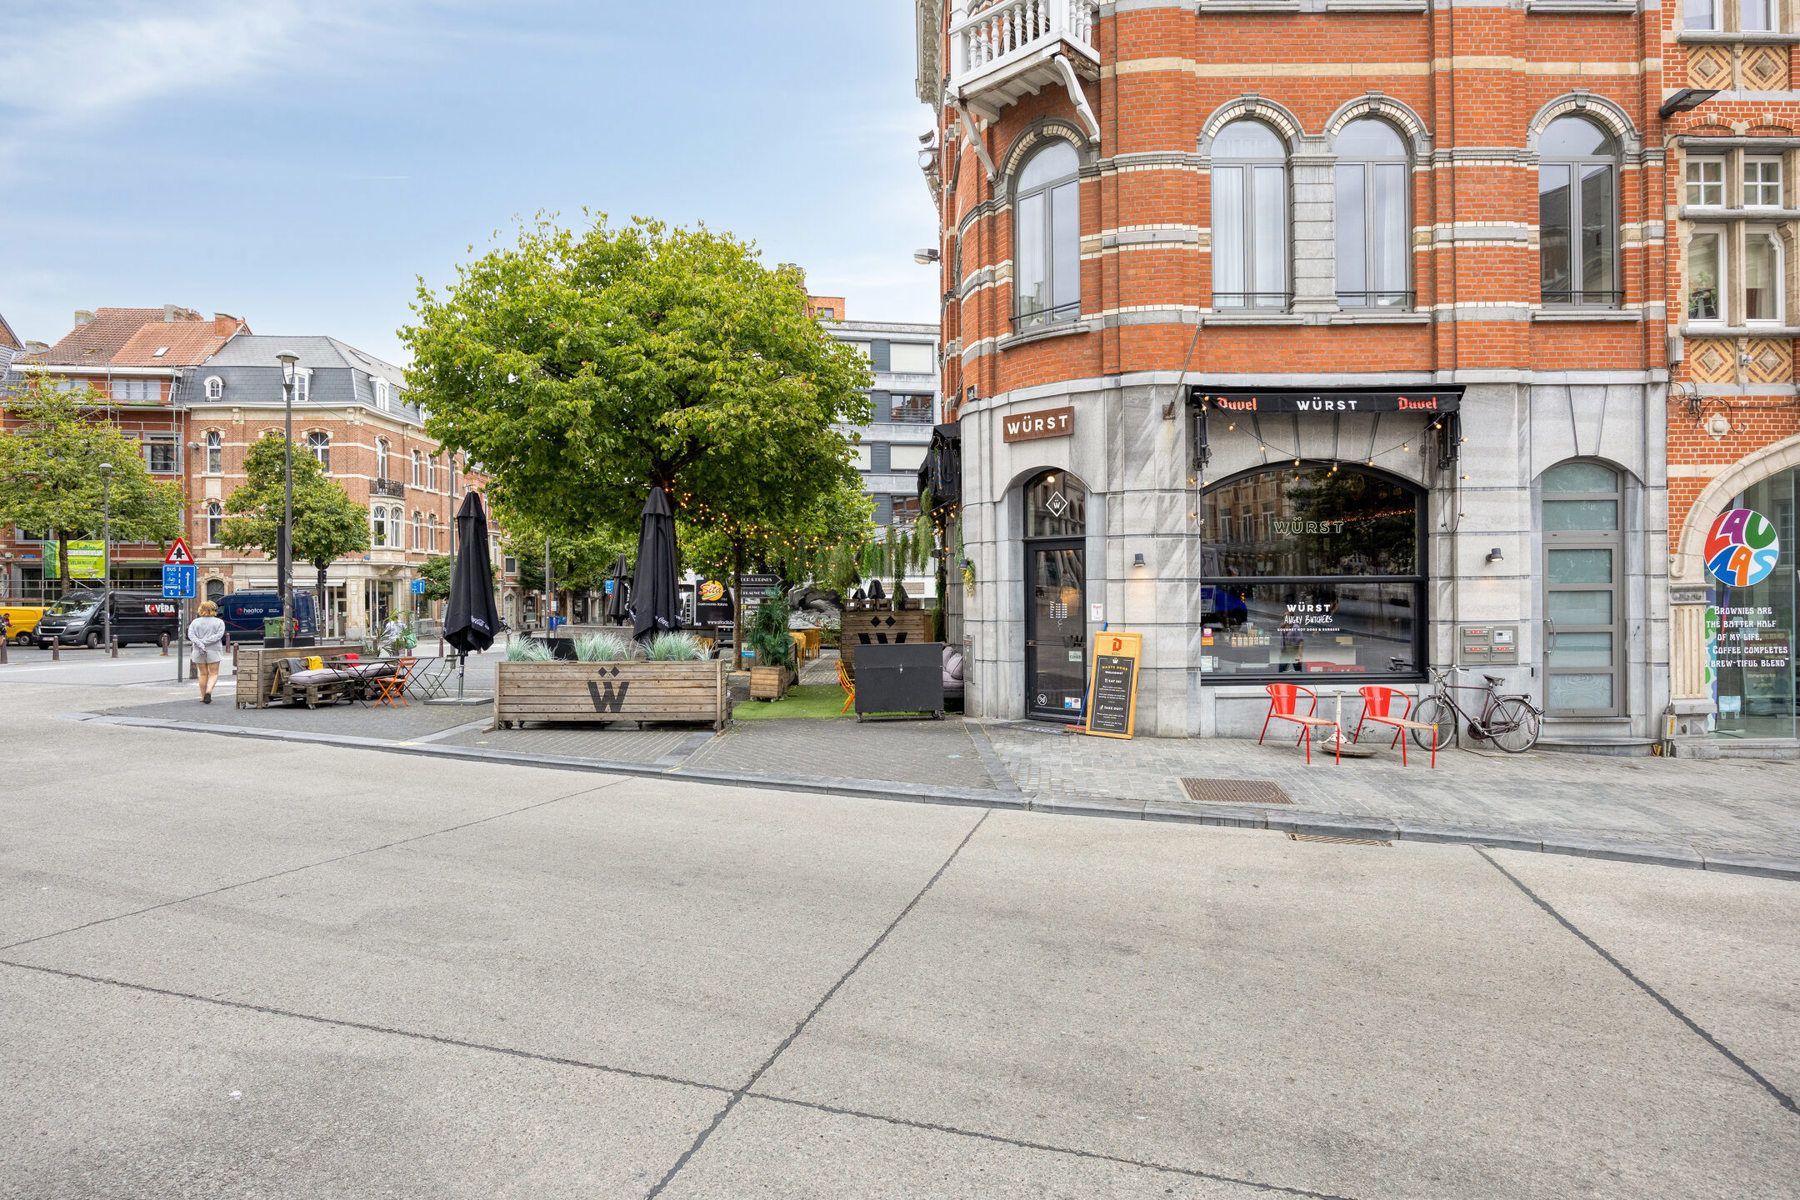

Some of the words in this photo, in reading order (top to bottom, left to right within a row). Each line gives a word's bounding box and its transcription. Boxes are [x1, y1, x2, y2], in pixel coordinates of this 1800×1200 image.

[1217, 397, 1257, 411] Duvel
[1296, 396, 1358, 411] WÜRST
[1398, 397, 1438, 410] Duvel
[1007, 415, 1068, 435] WÜRST
[1273, 516, 1344, 534] WÜRST
[1286, 601, 1331, 612] WÜRST
[1723, 620, 1754, 628] BATTER
[1729, 633, 1741, 641] MY
[1743, 646, 1789, 654] COMPLETES
